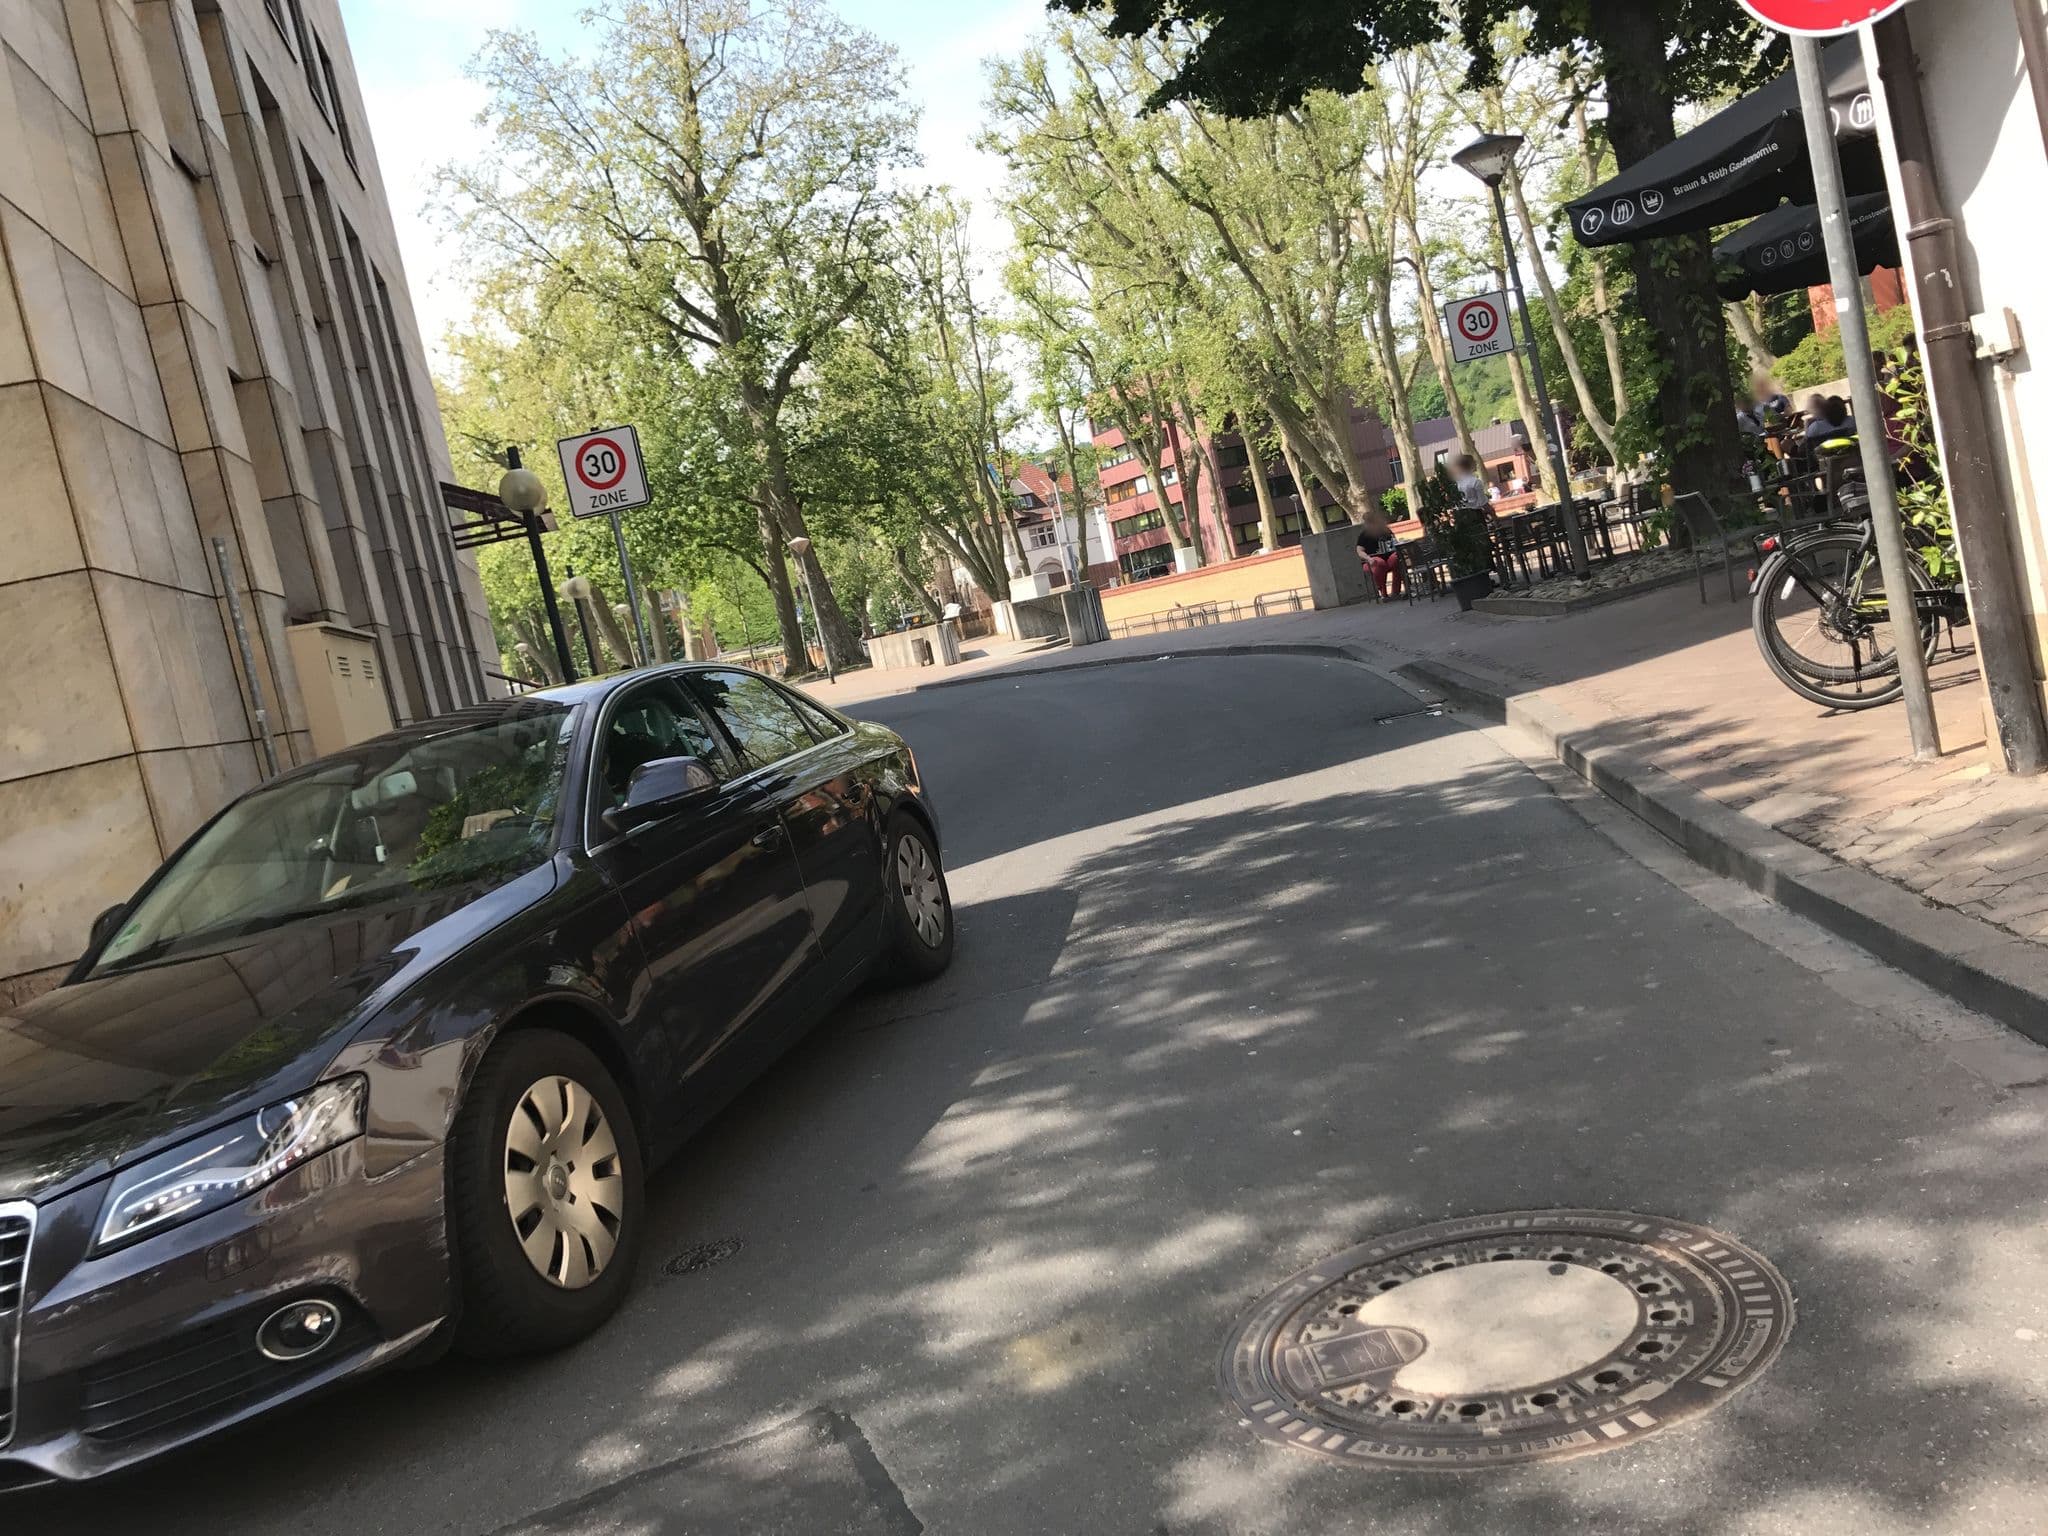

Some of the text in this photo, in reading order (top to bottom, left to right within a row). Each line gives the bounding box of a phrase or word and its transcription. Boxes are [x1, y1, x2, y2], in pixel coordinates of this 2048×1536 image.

[1673, 142, 1779, 196] Braun & Röth Gastronomie
[1466, 310, 1490, 332] 30
[1469, 340, 1499, 356] ZONE
[585, 451, 617, 477] 30
[590, 489, 629, 508] ZONE
